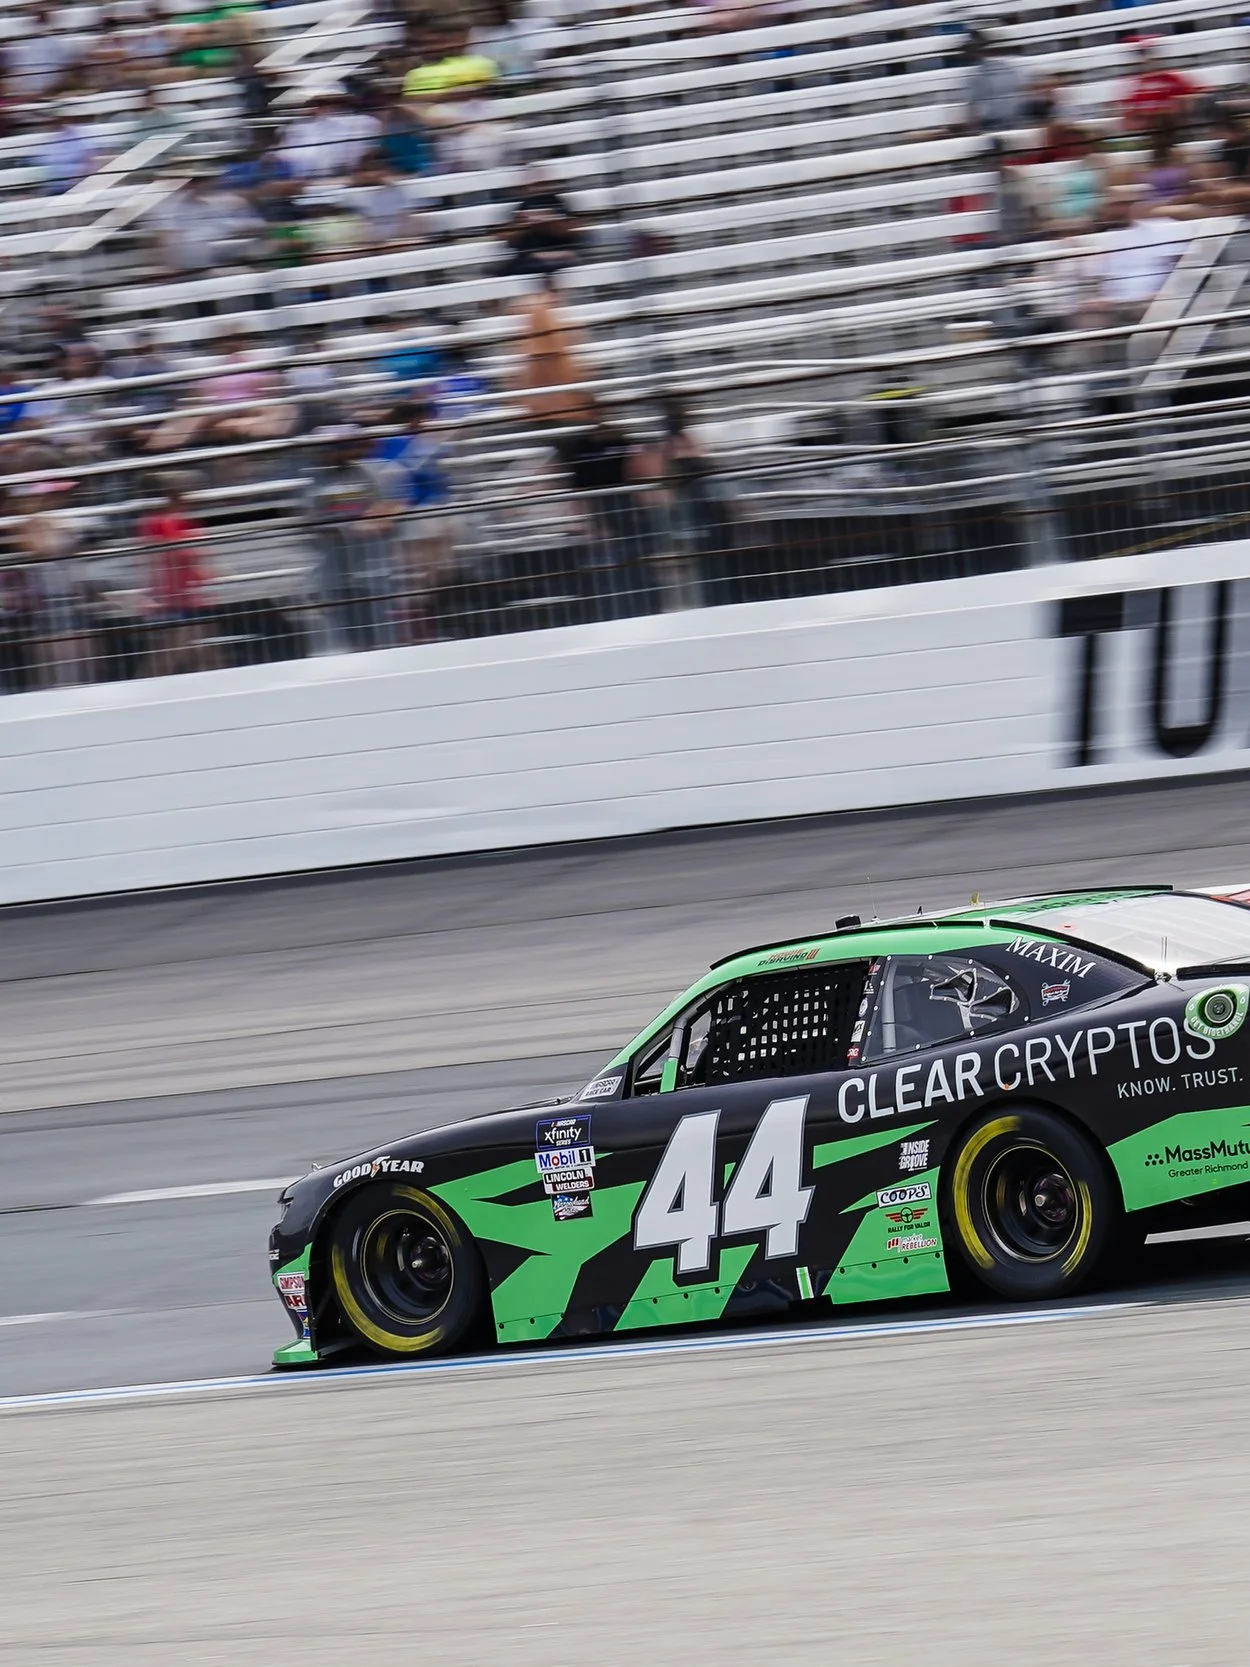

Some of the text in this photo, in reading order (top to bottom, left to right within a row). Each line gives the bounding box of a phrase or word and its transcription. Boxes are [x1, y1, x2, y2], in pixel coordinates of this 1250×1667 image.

[1005, 935, 1097, 978] MAXIM
[1190, 1016, 1205, 1030] GET
[838, 1016, 1217, 1124] CLEAR CRYPTOS
[1117, 1076, 1177, 1099] KNOW.
[1180, 1067, 1244, 1089] TRUST.
[544, 1127, 582, 1143] xfinity
[538, 1150, 576, 1168] Mobil
[899, 1153, 928, 1170] GROOVE
[545, 1170, 585, 1183] LINCOLN
[1168, 1161, 1249, 1178] Greater Richmond
[555, 1180, 590, 1191] WELDERS
[633, 1094, 817, 1275] 44
[880, 1184, 929, 1205] COOP'S
[914, 1221, 931, 1229] VALOR
[901, 1239, 937, 1251] REBELLION
